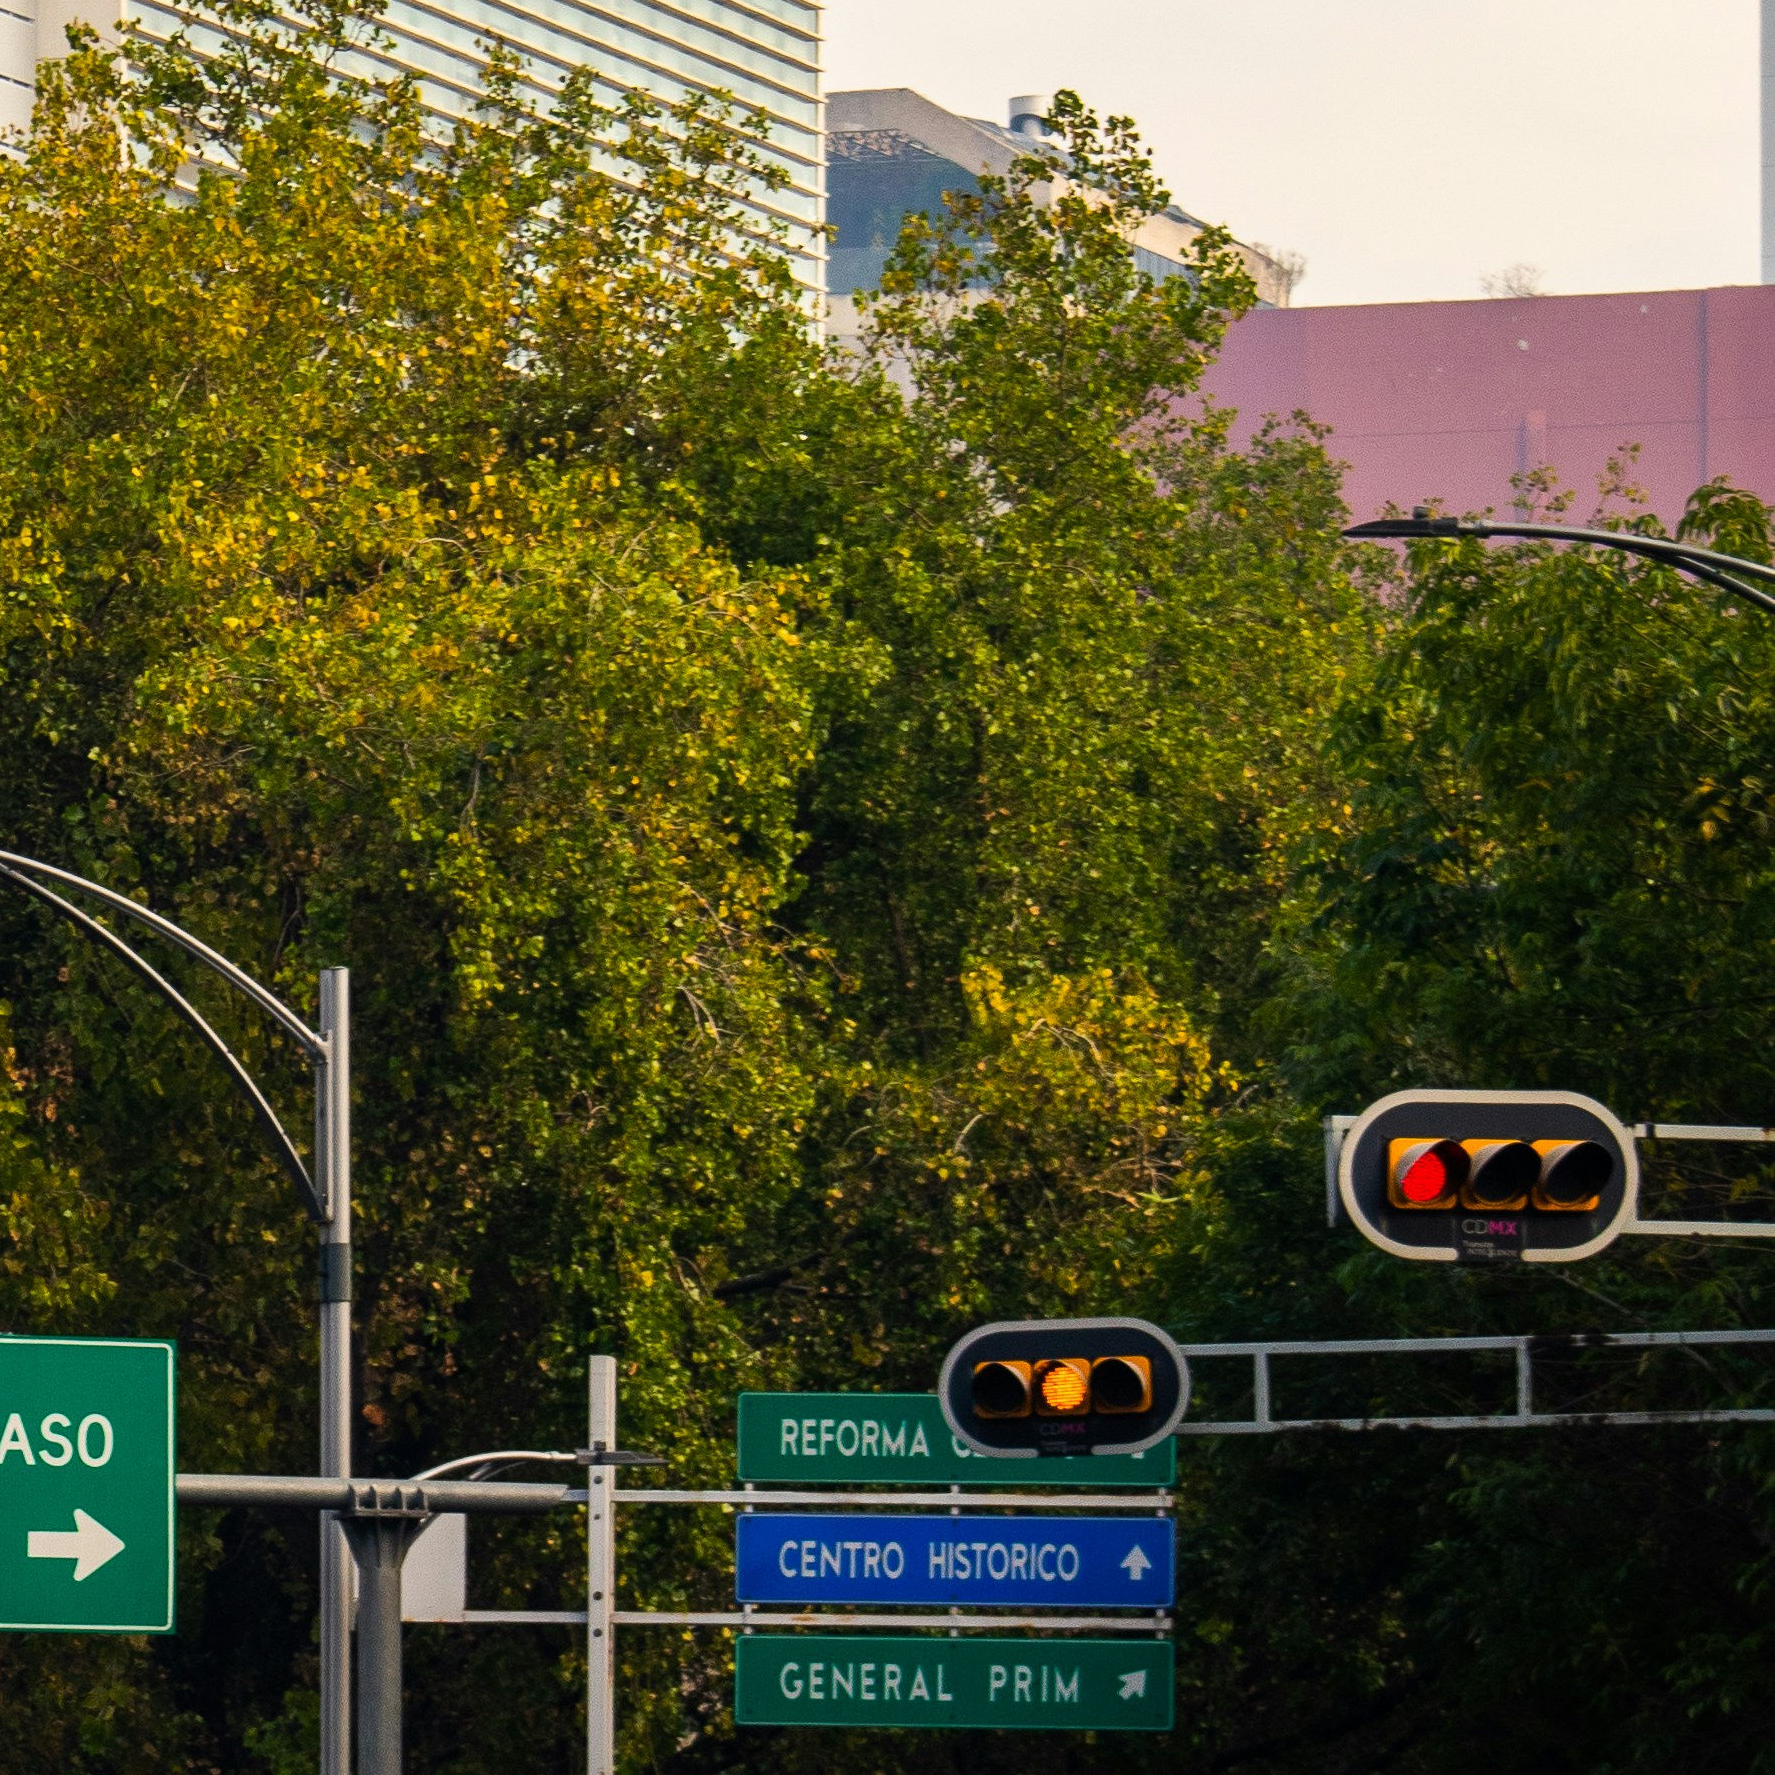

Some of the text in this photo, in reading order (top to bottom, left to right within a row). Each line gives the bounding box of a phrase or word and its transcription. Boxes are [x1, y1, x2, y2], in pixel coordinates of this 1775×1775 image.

[1461, 1218, 1517, 1235] CDMX
[780, 1418, 930, 1457] REFORMA
[778, 1540, 1080, 1581] CENTRO HISTORICO
[779, 1661, 1080, 1703] GENERAL PRIM
